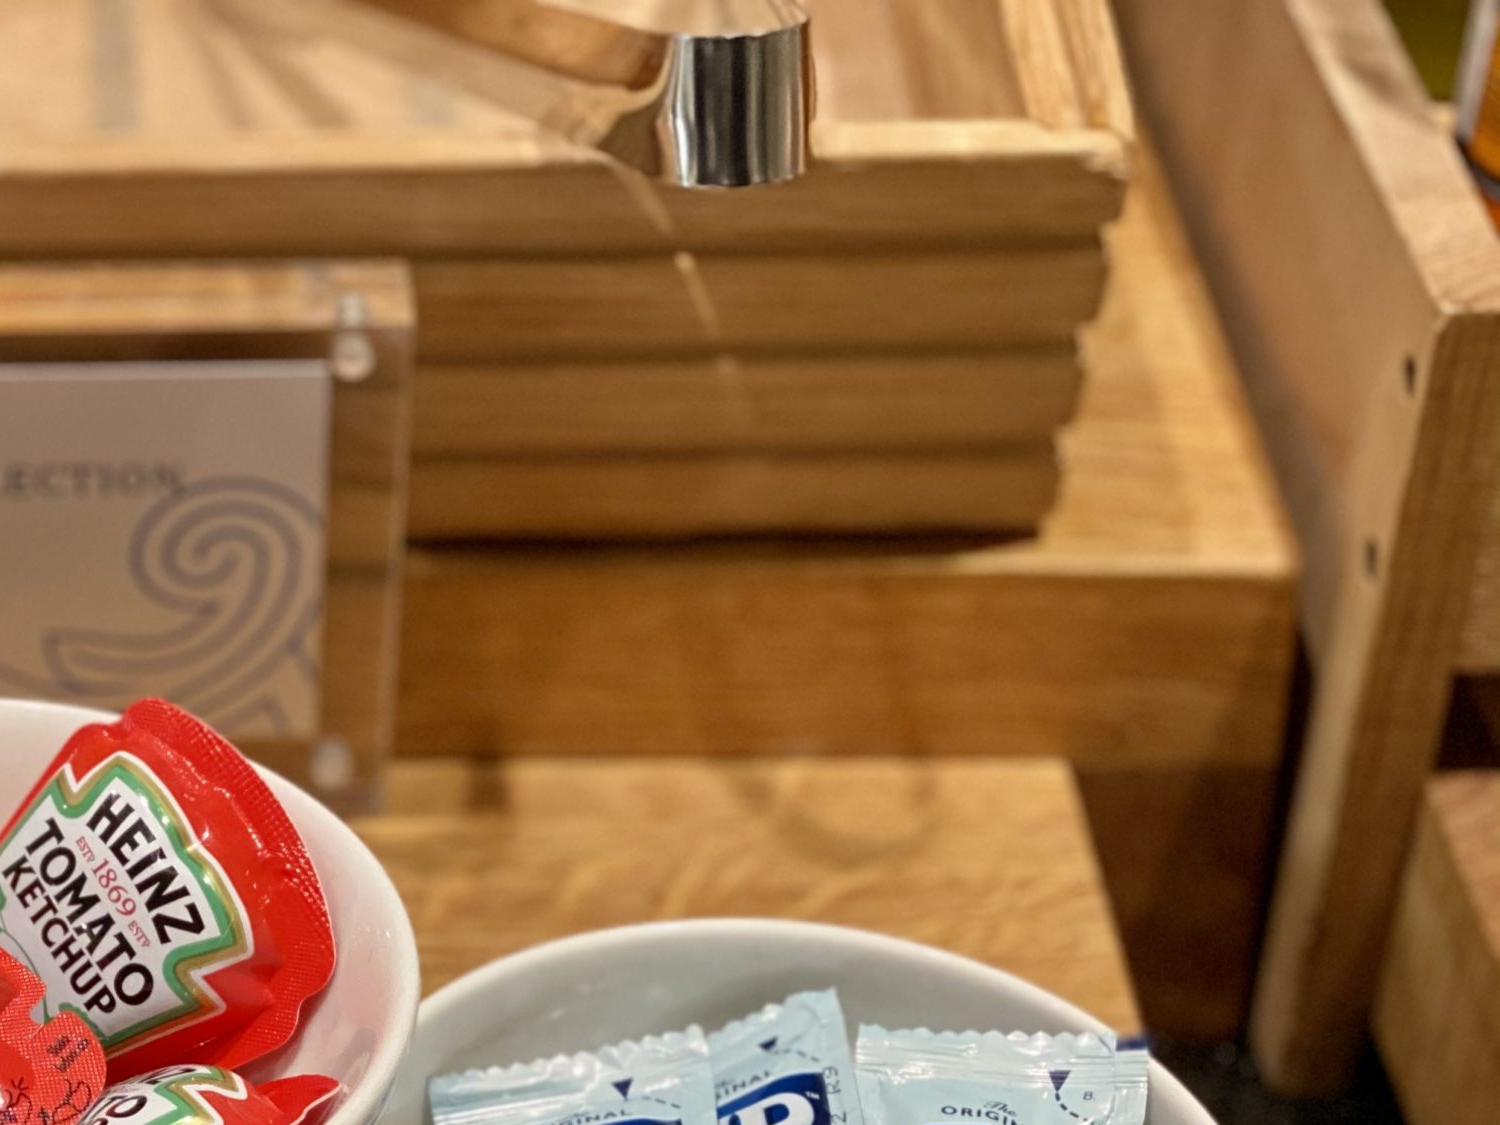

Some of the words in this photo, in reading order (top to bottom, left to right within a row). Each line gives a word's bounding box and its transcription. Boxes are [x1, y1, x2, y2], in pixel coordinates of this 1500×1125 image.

[2, 855, 117, 1014] KETCHUP
[24, 817, 154, 1006] TOMATO
[86, 792, 206, 944] HEINZ
[92, 858, 136, 917] 1869
